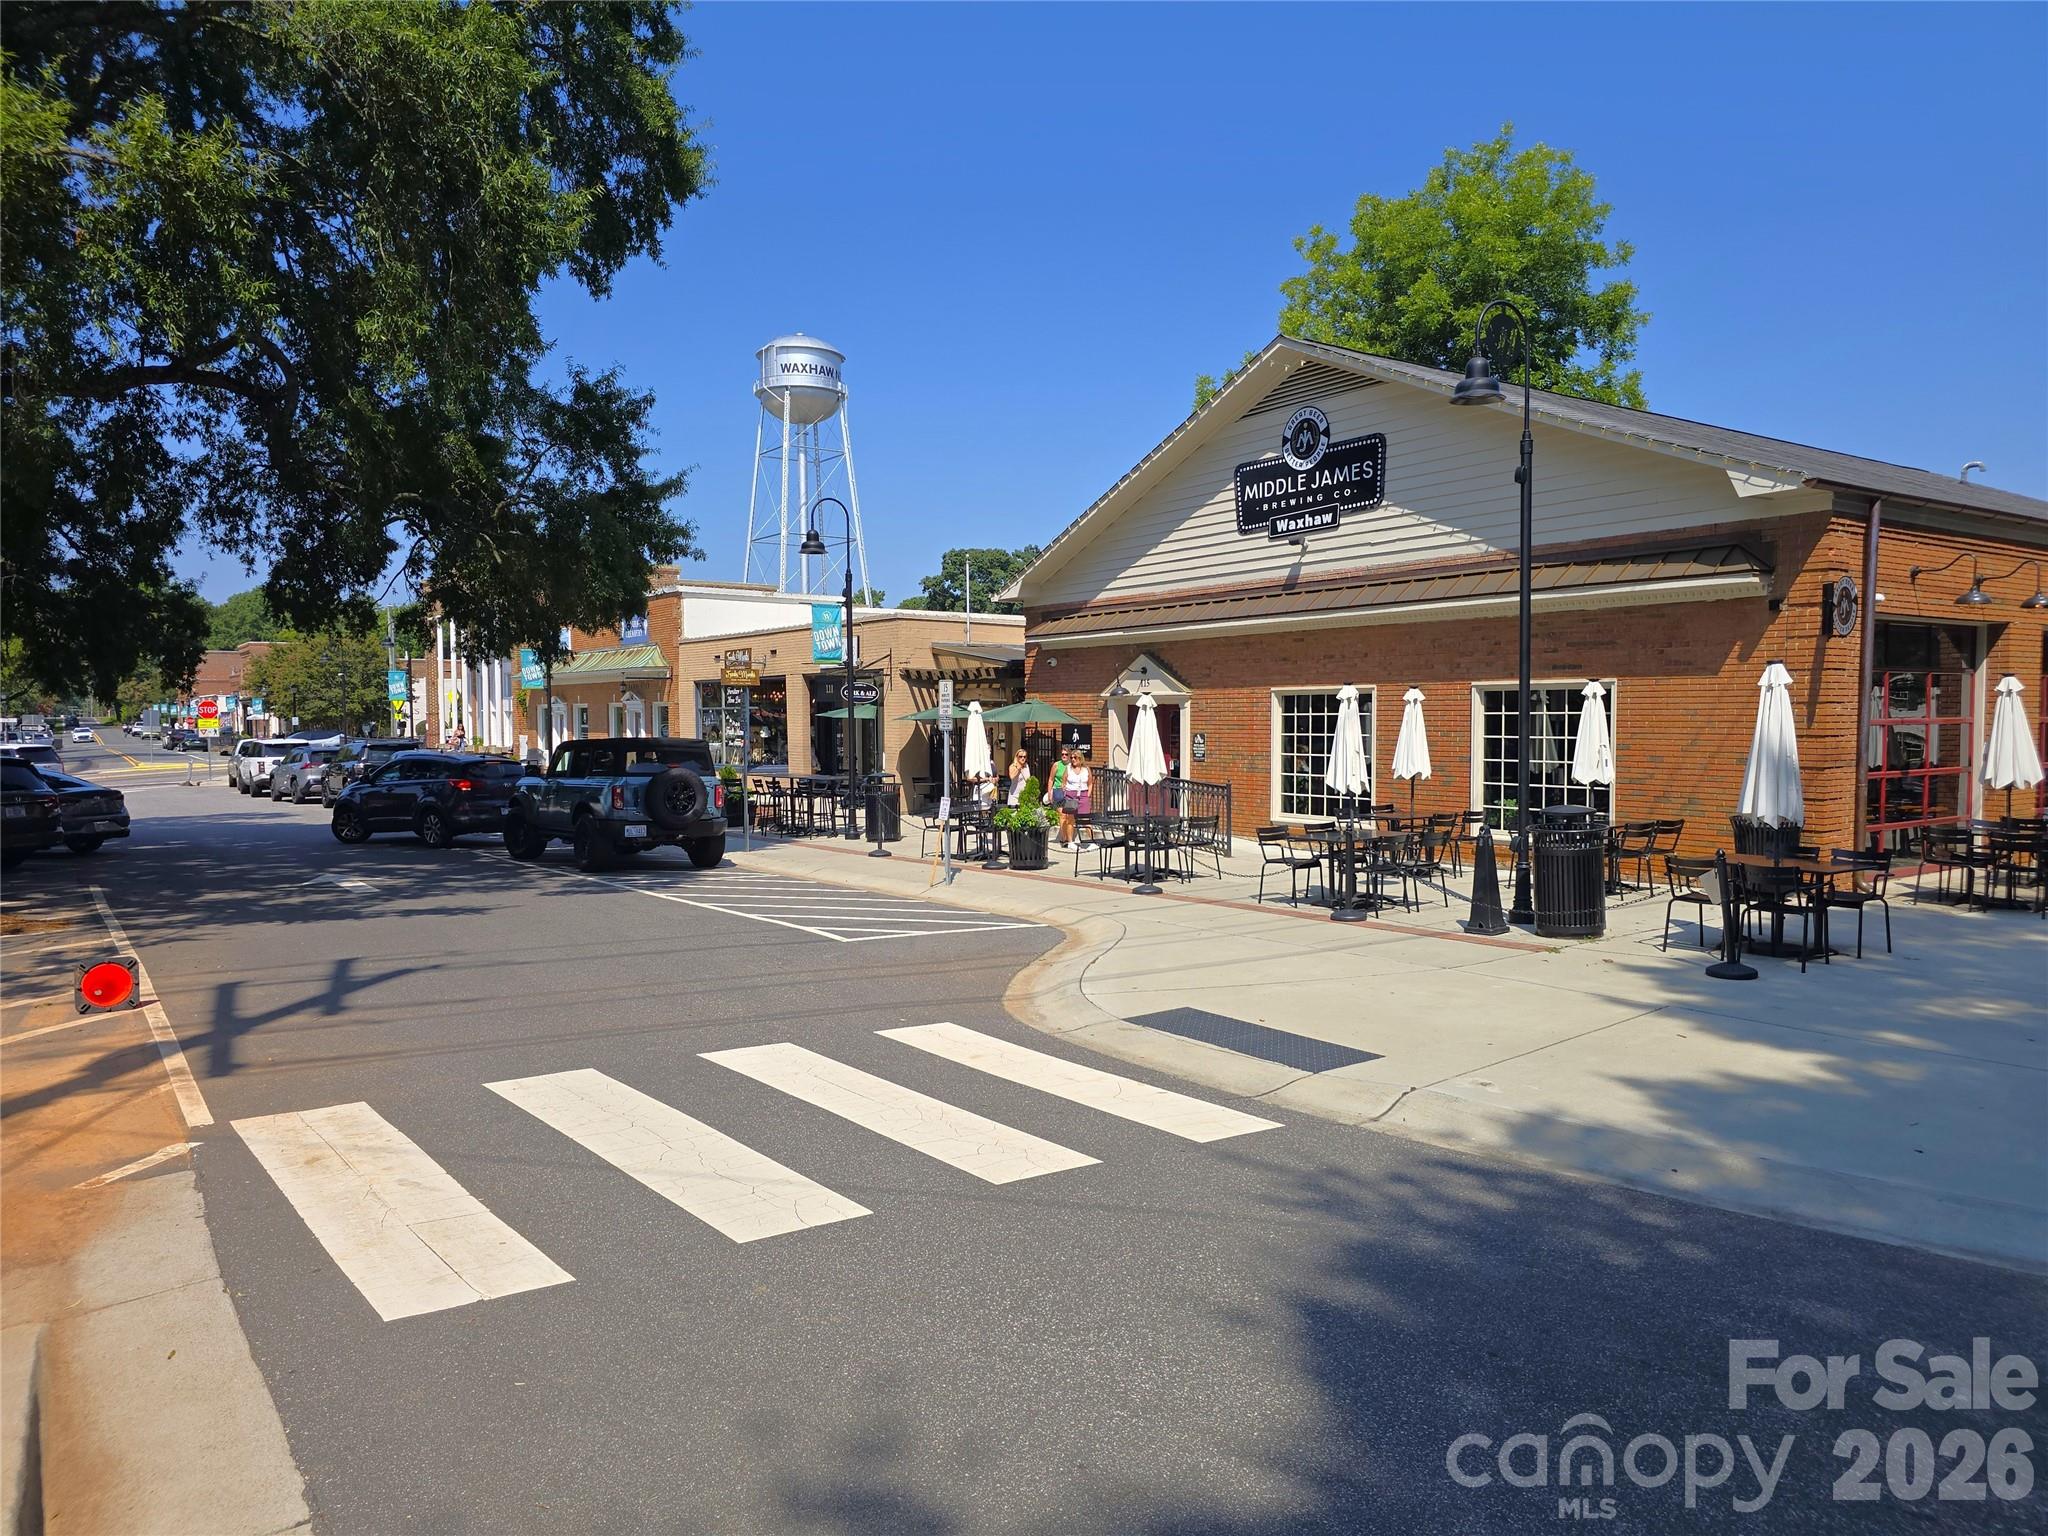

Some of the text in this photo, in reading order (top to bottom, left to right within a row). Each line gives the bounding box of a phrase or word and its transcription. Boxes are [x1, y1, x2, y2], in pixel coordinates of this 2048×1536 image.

[1288, 410, 1324, 431] GREAT BEER
[1284, 443, 1326, 468] BETTER PEOPLE
[1244, 460, 1374, 502] MIDDLE JAMES
[1262, 493, 1324, 511] BREWING
[1276, 512, 1333, 533] Waxhaw
[813, 625, 840, 642] DOWN
[815, 637, 842, 652] TOWN
[199, 706, 218, 714] STOP
